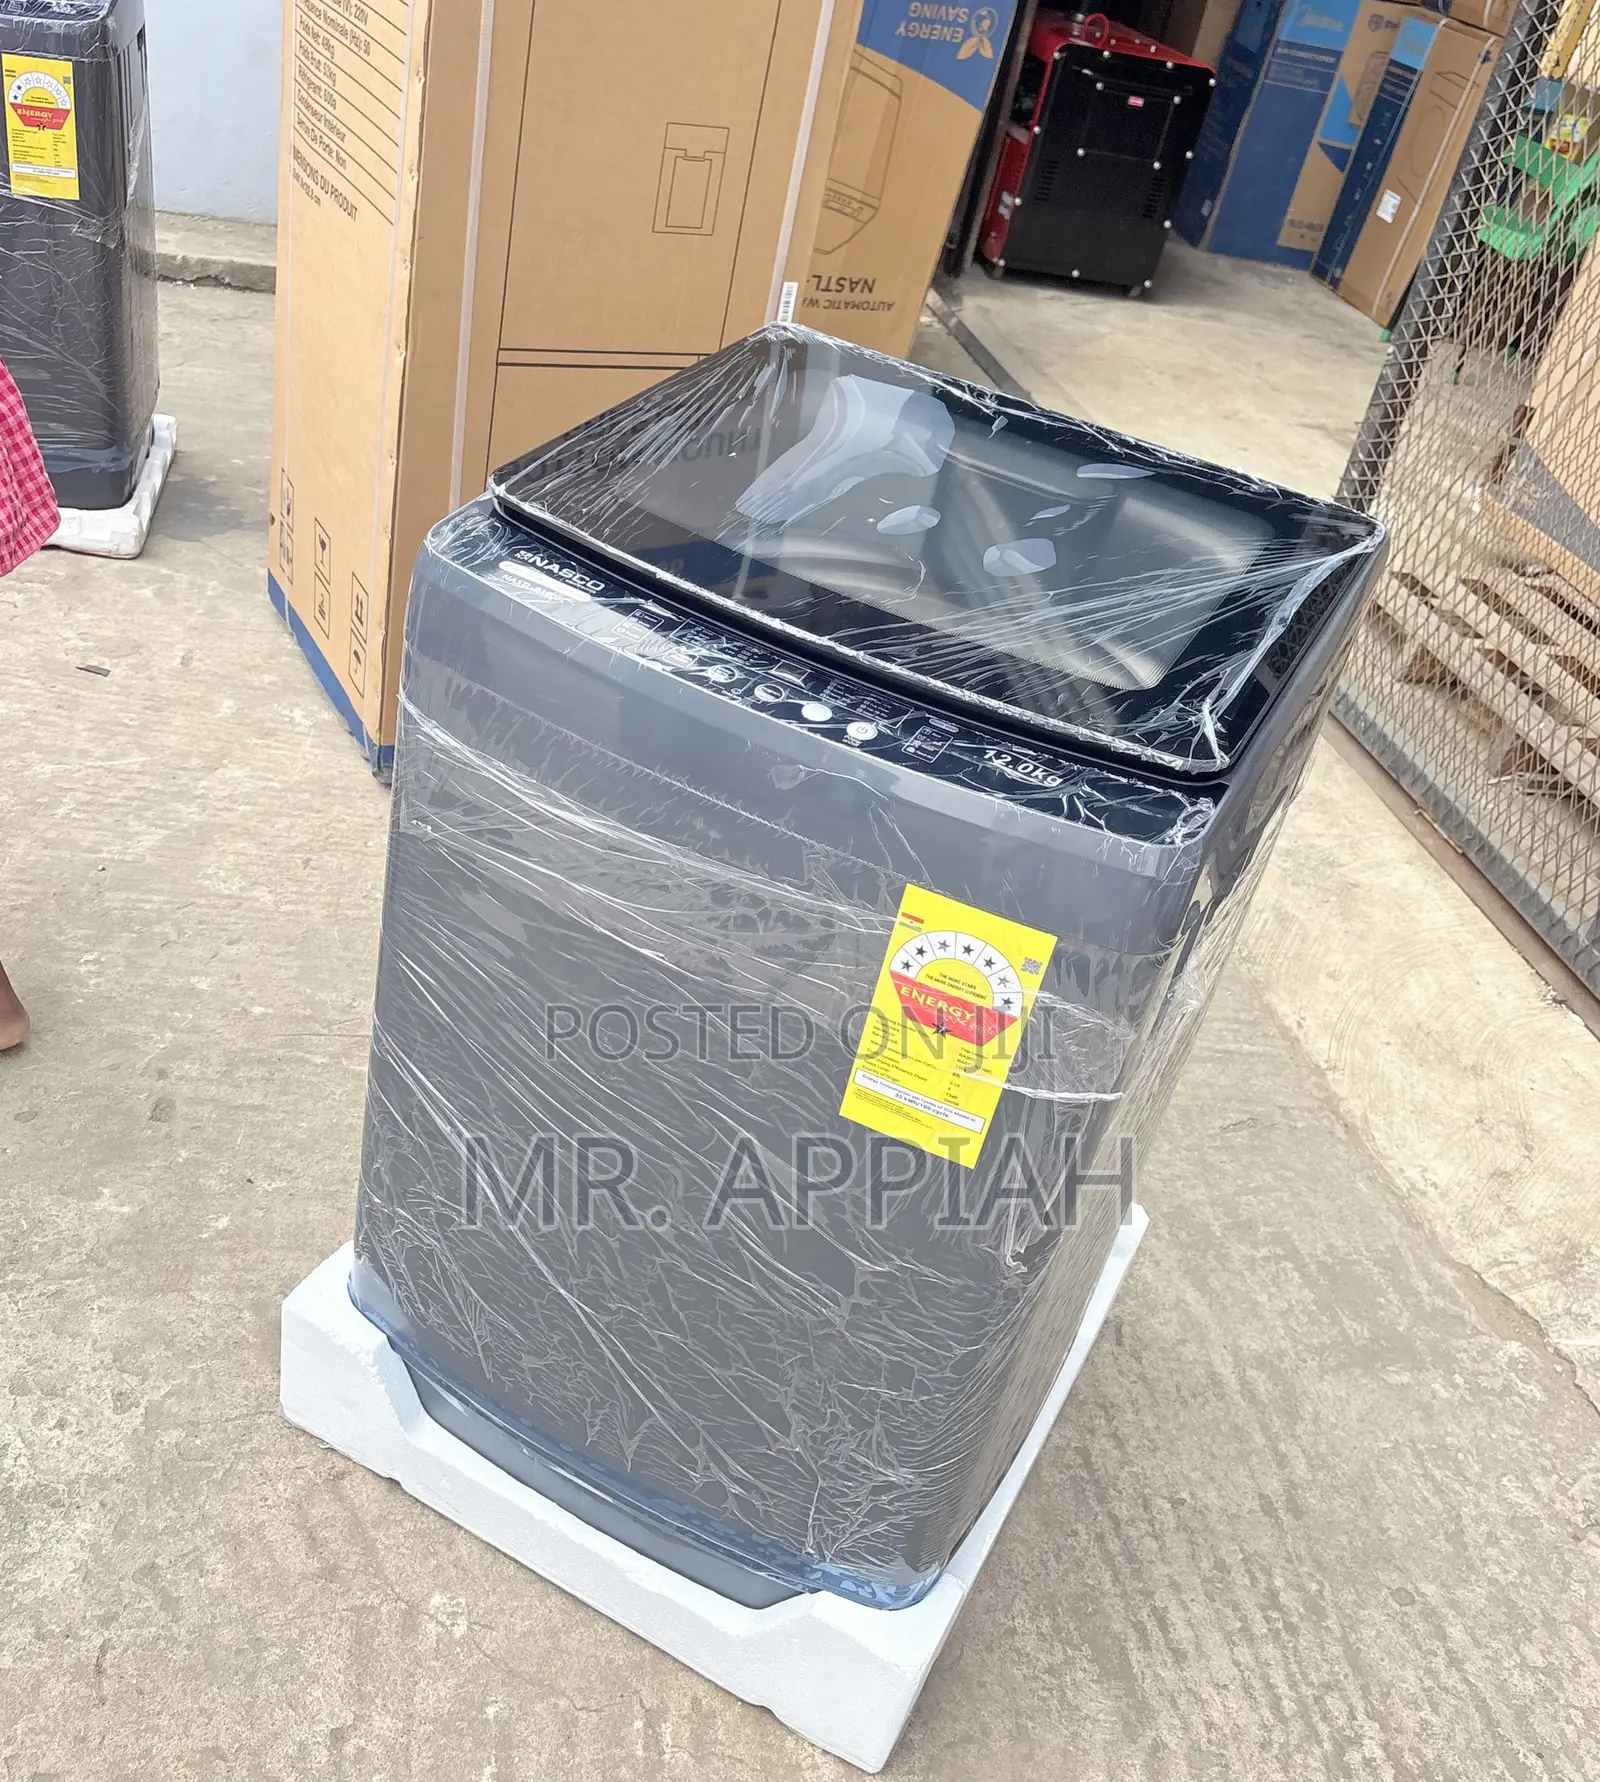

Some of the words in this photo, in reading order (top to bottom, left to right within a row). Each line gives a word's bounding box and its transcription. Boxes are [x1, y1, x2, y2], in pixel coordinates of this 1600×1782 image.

[908, 2, 969, 23] SAVING
[895, 21, 964, 43] ENERGY
[16, 107, 54, 118] ENERGY
[330, 184, 358, 222] PRODUIT
[825, 300, 895, 312] AUTOMATIC
[528, 553, 606, 591] NASCO
[984, 749, 1064, 788] 12.0kg
[899, 984, 976, 1022] ENERGY
